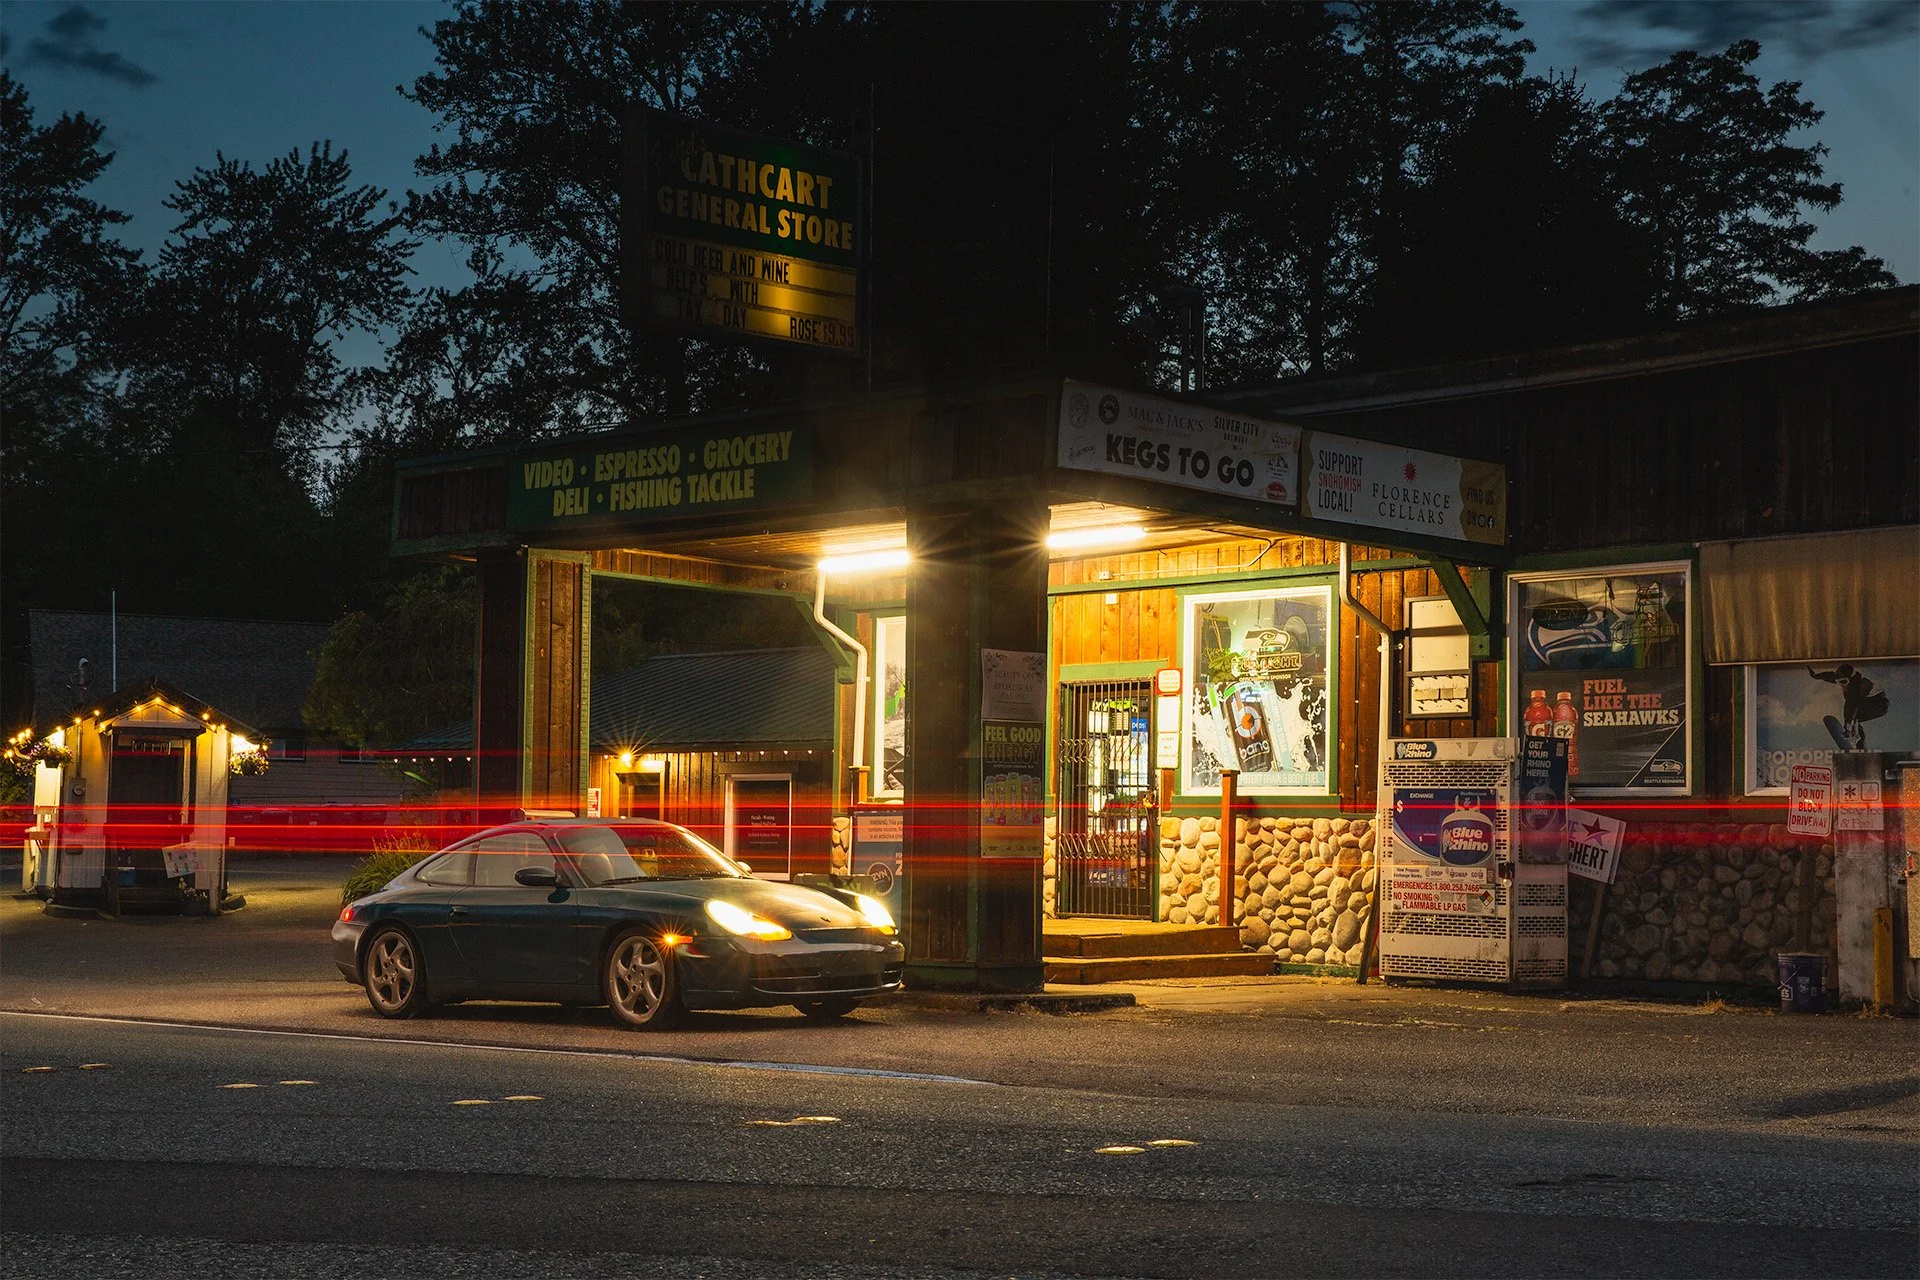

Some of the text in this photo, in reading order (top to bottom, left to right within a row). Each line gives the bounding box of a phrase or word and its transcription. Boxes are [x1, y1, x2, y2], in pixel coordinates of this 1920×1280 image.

[682, 149, 833, 210] CATHCART
[657, 184, 853, 253] GENERAL STORE
[694, 244, 723, 273] BEER
[730, 254, 755, 278] AND
[761, 258, 790, 284] WINE
[730, 279, 758, 304] WITH
[723, 304, 747, 329] DAY
[1128, 406, 1153, 422] MAC
[1156, 412, 1164, 425] &
[1167, 414, 1203, 432] JACK'S
[1214, 416, 1261, 437] SILVER CITY
[524, 431, 793, 491] VIDEO ESPRESSO GROCERY
[1105, 433, 1171, 473] KEGS
[1179, 446, 1210, 480] TO
[1217, 455, 1255, 488] GO
[1318, 449, 1363, 477] SUPPORT
[1318, 471, 1363, 494] SNOHOMISH
[553, 468, 756, 518] DELI FISHING TACKLE
[1318, 488, 1353, 514] LOCAL!
[1372, 482, 1451, 510] FLORENCE
[1467, 487, 1495, 506] FIND US
[1378, 502, 1445, 526] CELLARS
[1467, 510, 1477, 526] ON
[1583, 679, 1627, 694] FUEL
[1583, 693, 1662, 711] LIKE THE
[1583, 709, 1679, 727] SEAHAWKS
[985, 725, 1041, 744] FEEL GOOD
[1554, 725, 1573, 738] G2
[1239, 739, 1269, 759] bang
[1405, 749, 1432, 758] Rhino
[1406, 743, 1427, 751] Blue
[1528, 741, 1544, 750] GET
[1528, 750, 1549, 759] YOUR
[1527, 759, 1551, 769] RHINO
[1763, 750, 1796, 765] POP
[1526, 769, 1550, 778] HERE!
[1792, 769, 1829, 782] NO PARKING
[1798, 788, 1824, 800] DO NOT
[1397, 799, 1404, 814] $
[1798, 801, 1823, 813] BLOCK
[1792, 815, 1829, 828] DRIVEWAY
[1452, 828, 1484, 840] Blue
[1449, 839, 1489, 852] Rhino
[1568, 840, 1609, 872] CHERT
[1393, 891, 1433, 902] NO SMOKING
[1402, 900, 1442, 911] FLAMMABLE
[1443, 902, 1452, 911] LP
[1453, 903, 1466, 912] GAS
